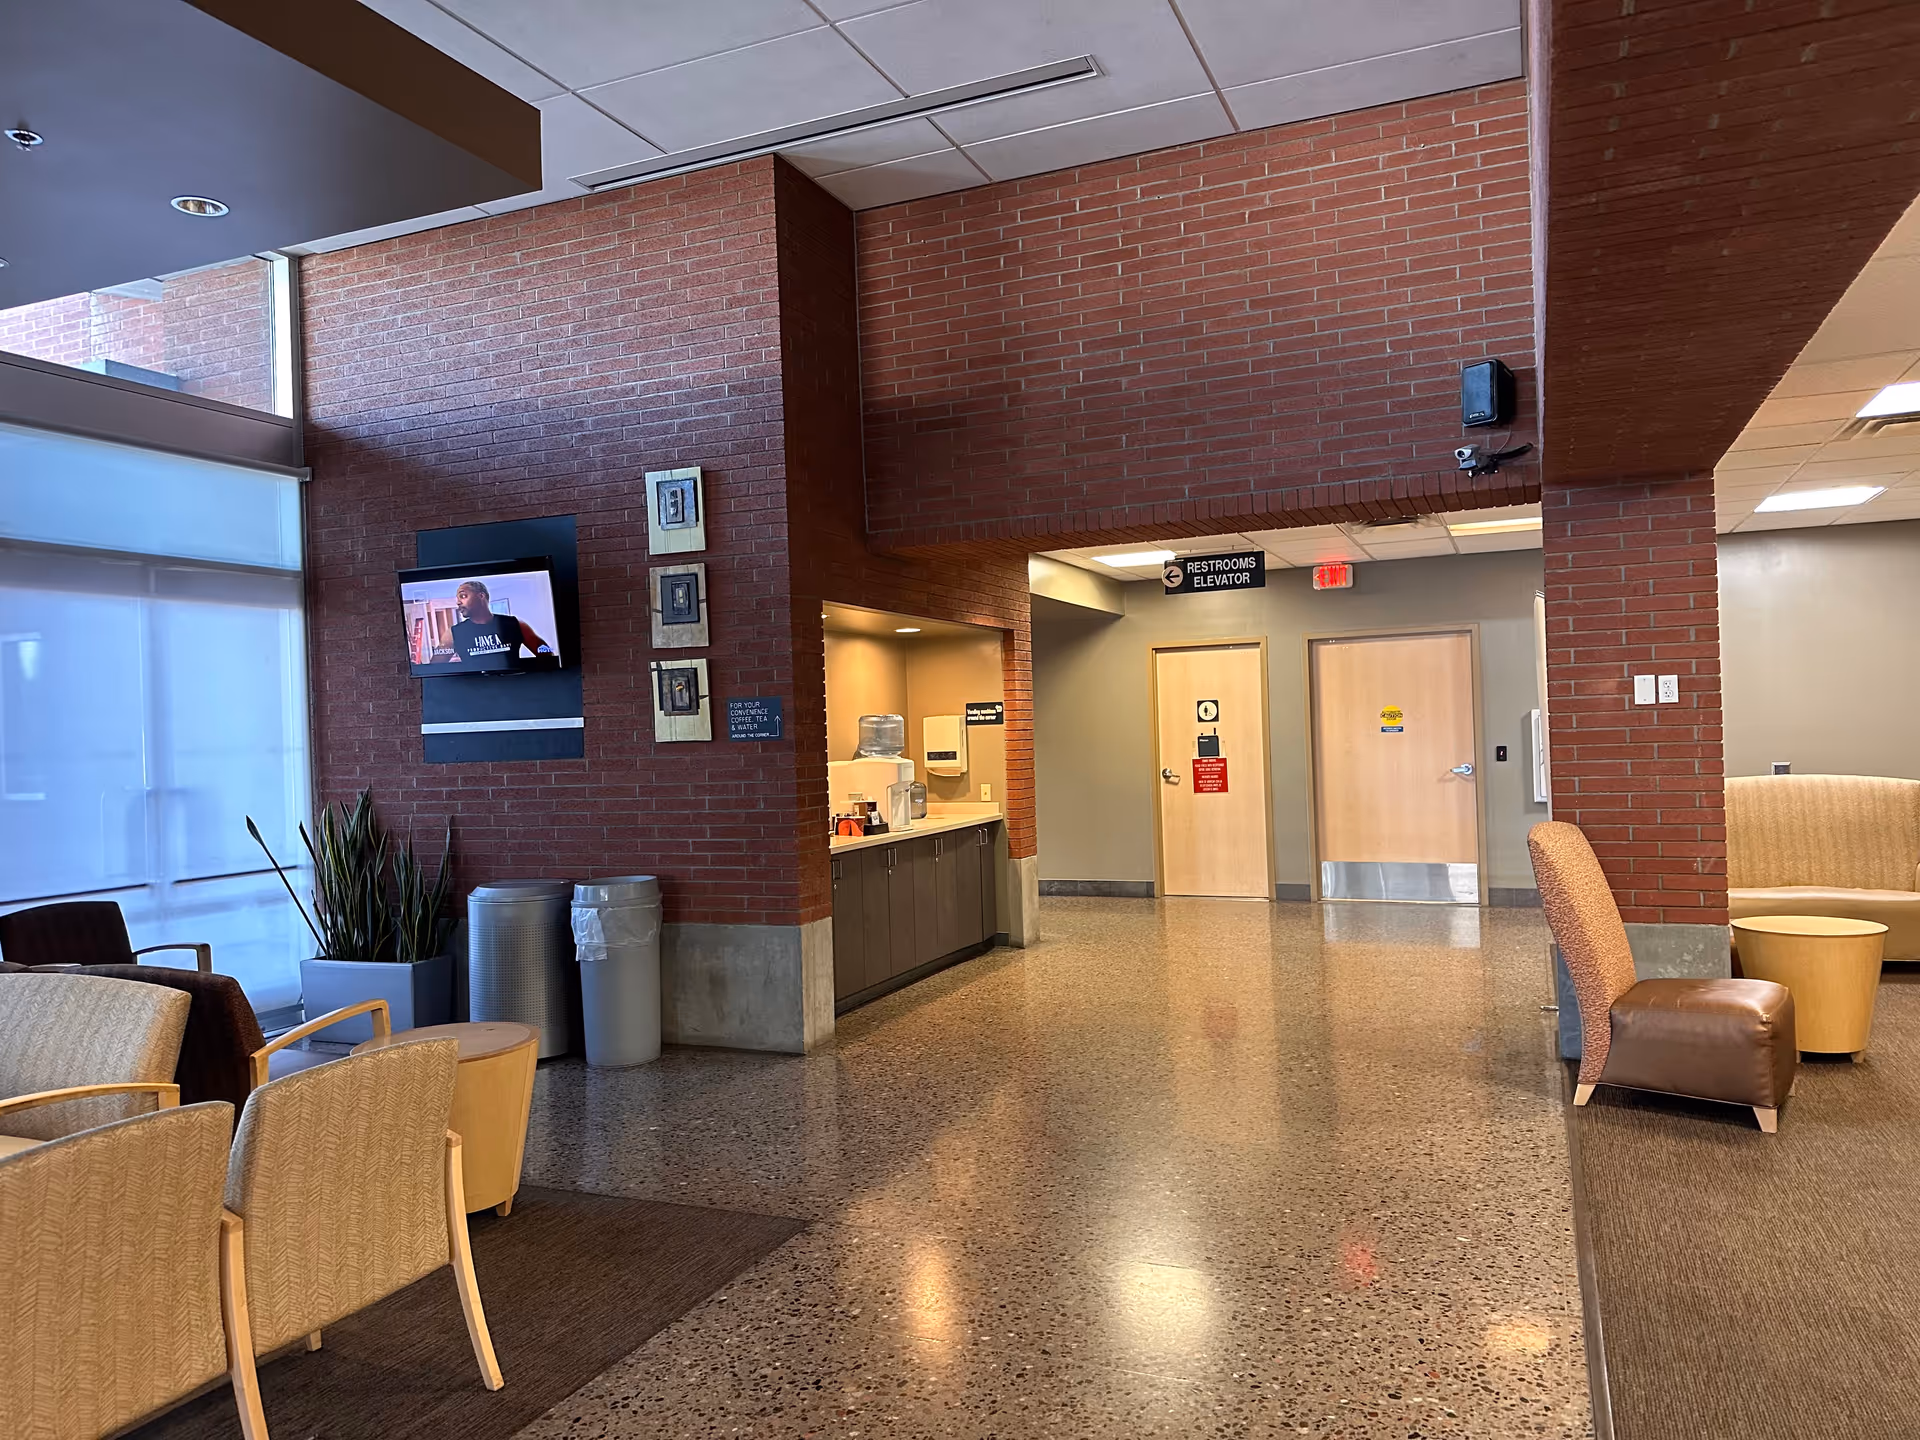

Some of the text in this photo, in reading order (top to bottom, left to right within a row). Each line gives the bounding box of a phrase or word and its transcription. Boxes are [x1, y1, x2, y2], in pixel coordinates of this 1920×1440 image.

[1187, 556, 1256, 574] RESTROOMS
[1193, 572, 1250, 588] ELEVATOR
[1319, 564, 1348, 588] EXIT
[474, 634, 496, 647] HAVE
[743, 701, 761, 709] YOUR
[730, 708, 769, 717] CONVENIENCE
[737, 723, 758, 731] WATER
